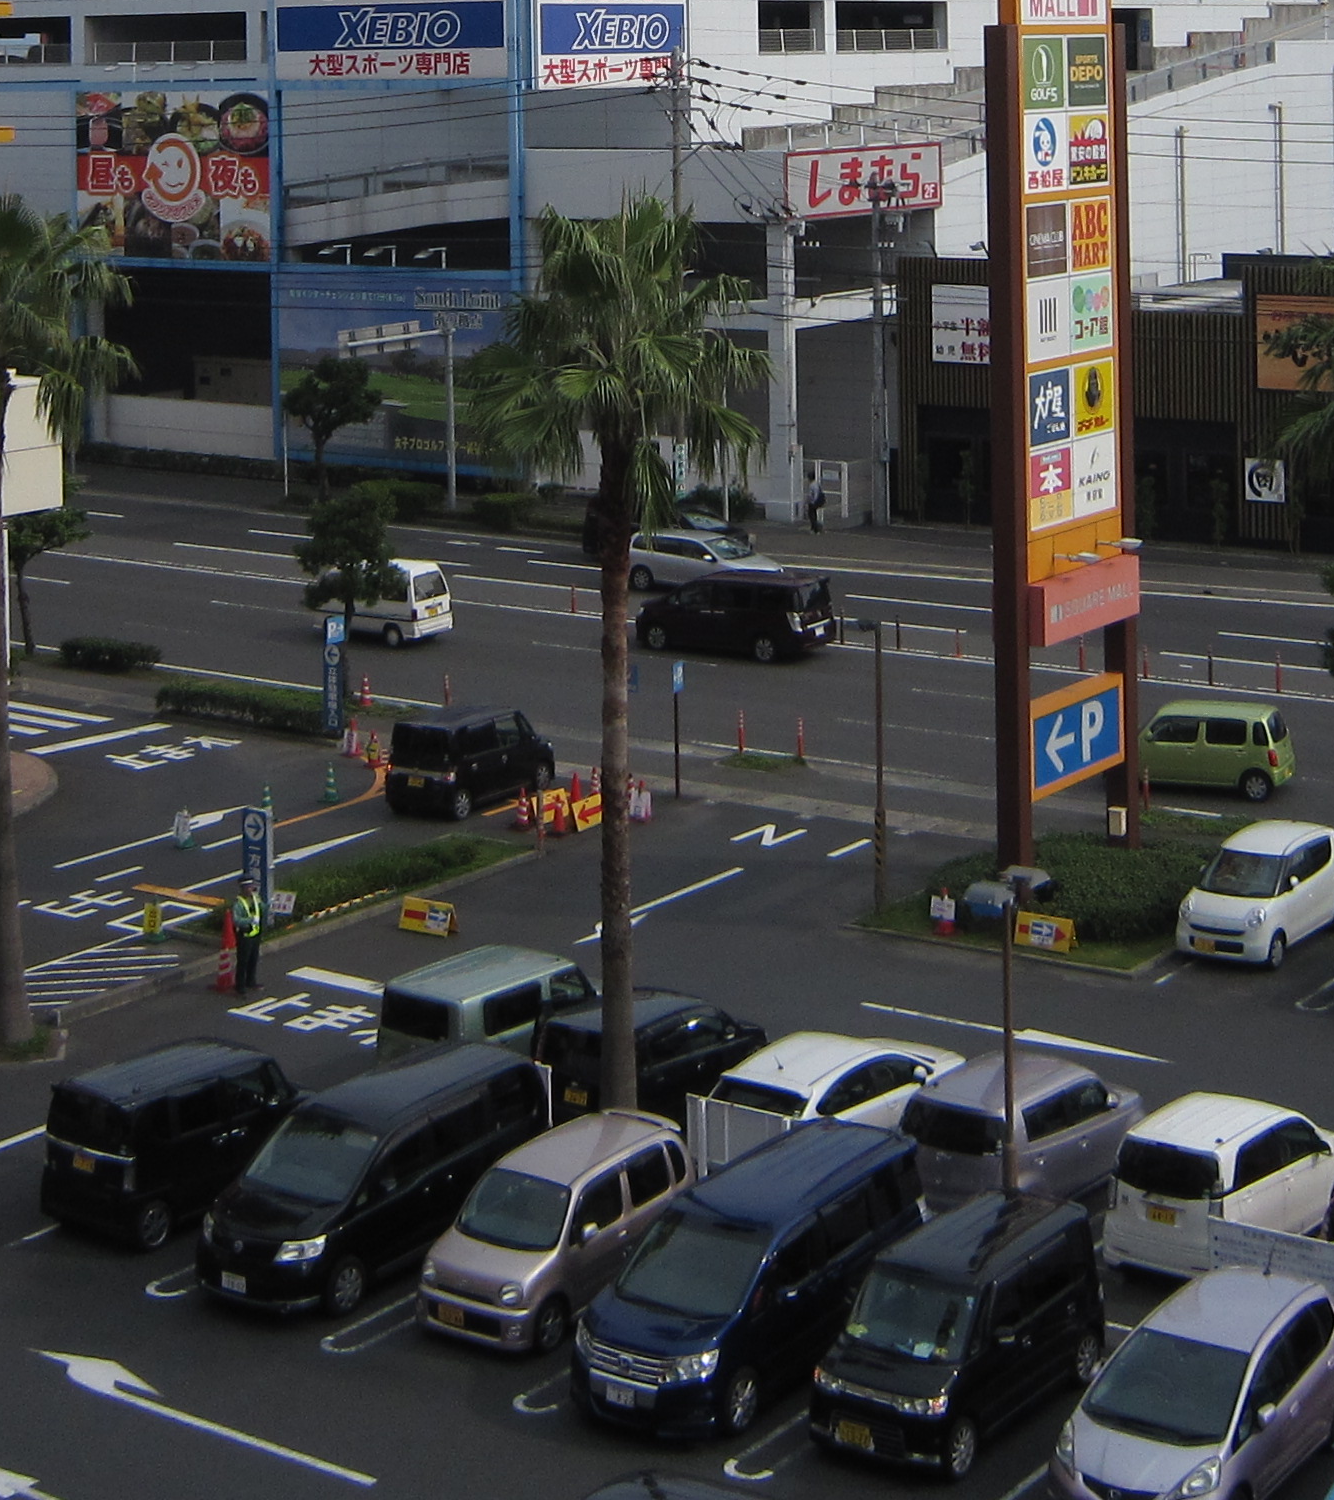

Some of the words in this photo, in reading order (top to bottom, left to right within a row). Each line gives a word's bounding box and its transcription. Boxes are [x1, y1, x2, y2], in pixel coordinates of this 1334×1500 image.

[335, 8, 461, 48] XEBIO
[572, 9, 670, 52] XEBIO
[309, 52, 470, 77] 大型スポーツ専門店
[543, 55, 684, 85] 大型スポーツ専門
[1070, 65, 1103, 82] DEPO
[1075, 54, 1098, 64] SPORTS
[1030, 87, 1057, 102] GOLF5
[88, 155, 135, 192] 昼も
[210, 156, 259, 196] 夜も
[808, 152, 923, 209] しまむら
[924, 184, 937, 199] 2F
[1028, 168, 1064, 190] 西松屋
[1072, 202, 1108, 241] ABC
[1072, 241, 1108, 268] MART
[1039, 463, 1063, 494] 本
[1065, 590, 1105, 618] SQUARE
[1108, 585, 1134, 601] MALL
[328, 621, 337, 639] P
[1081, 700, 1104, 762] P
[105, 735, 242, 769] 止まれ
